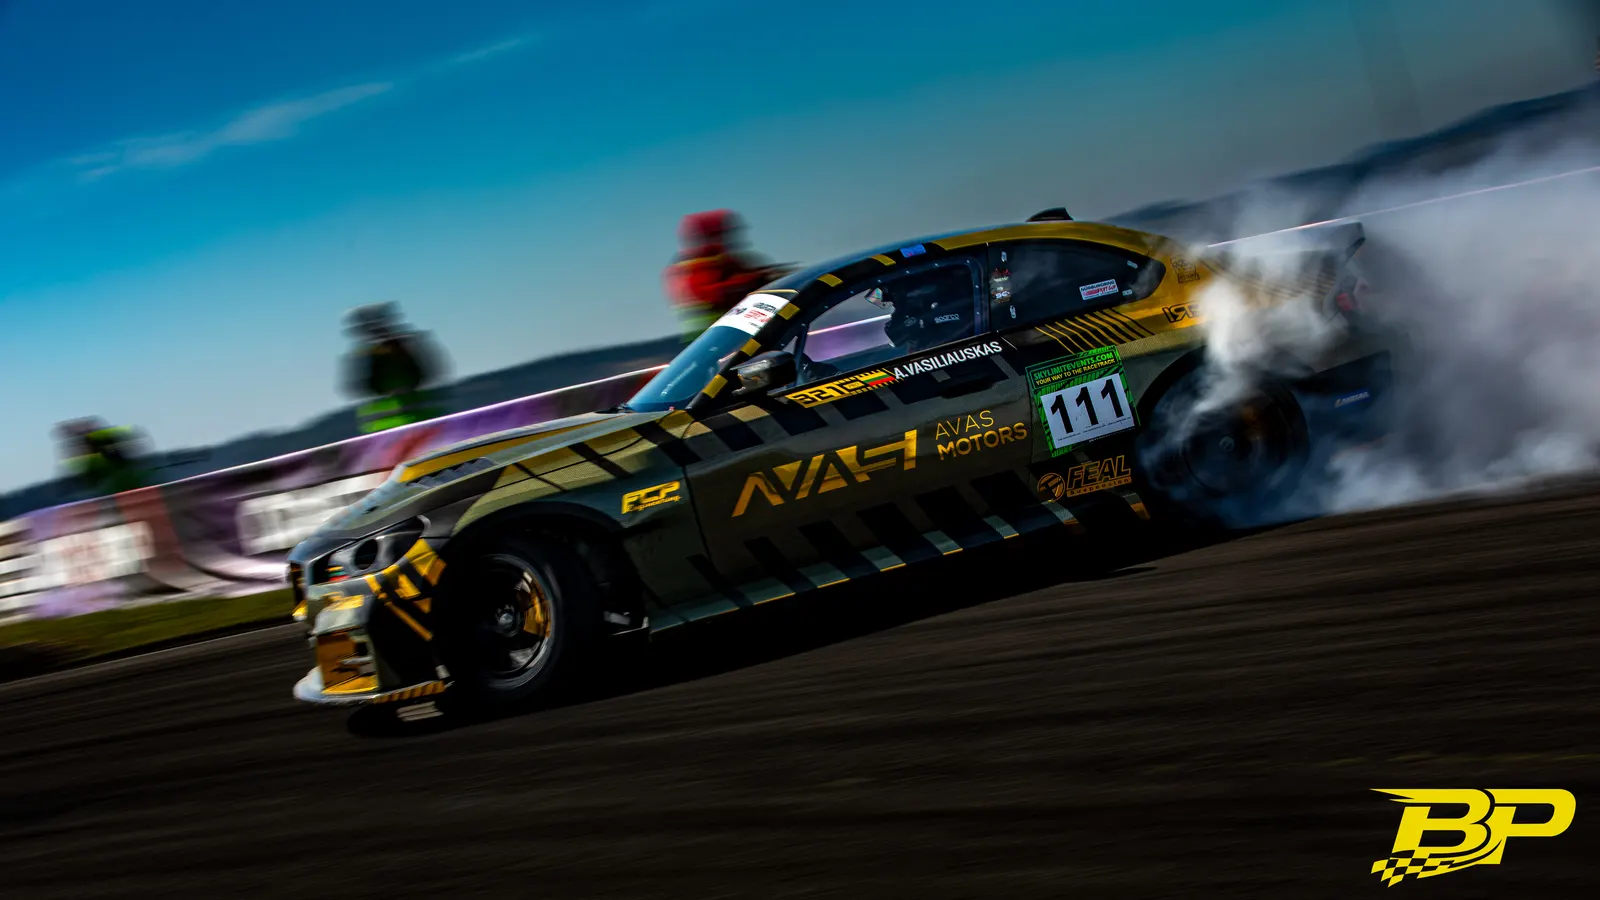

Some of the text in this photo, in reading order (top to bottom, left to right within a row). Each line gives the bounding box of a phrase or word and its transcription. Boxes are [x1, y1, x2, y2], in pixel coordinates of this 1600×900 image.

[893, 340, 1003, 381] A.VASILIAUSKAS
[1033, 351, 1115, 381] SKYLIMITEVENTS.COM
[1035, 358, 1116, 387] YOUR WAY TO THE RACETRACK
[1050, 378, 1124, 434] 111
[935, 409, 995, 441] AVAS
[936, 422, 1028, 461] MOTORS
[1067, 454, 1132, 490] FEAL
[621, 480, 681, 515] FCP
